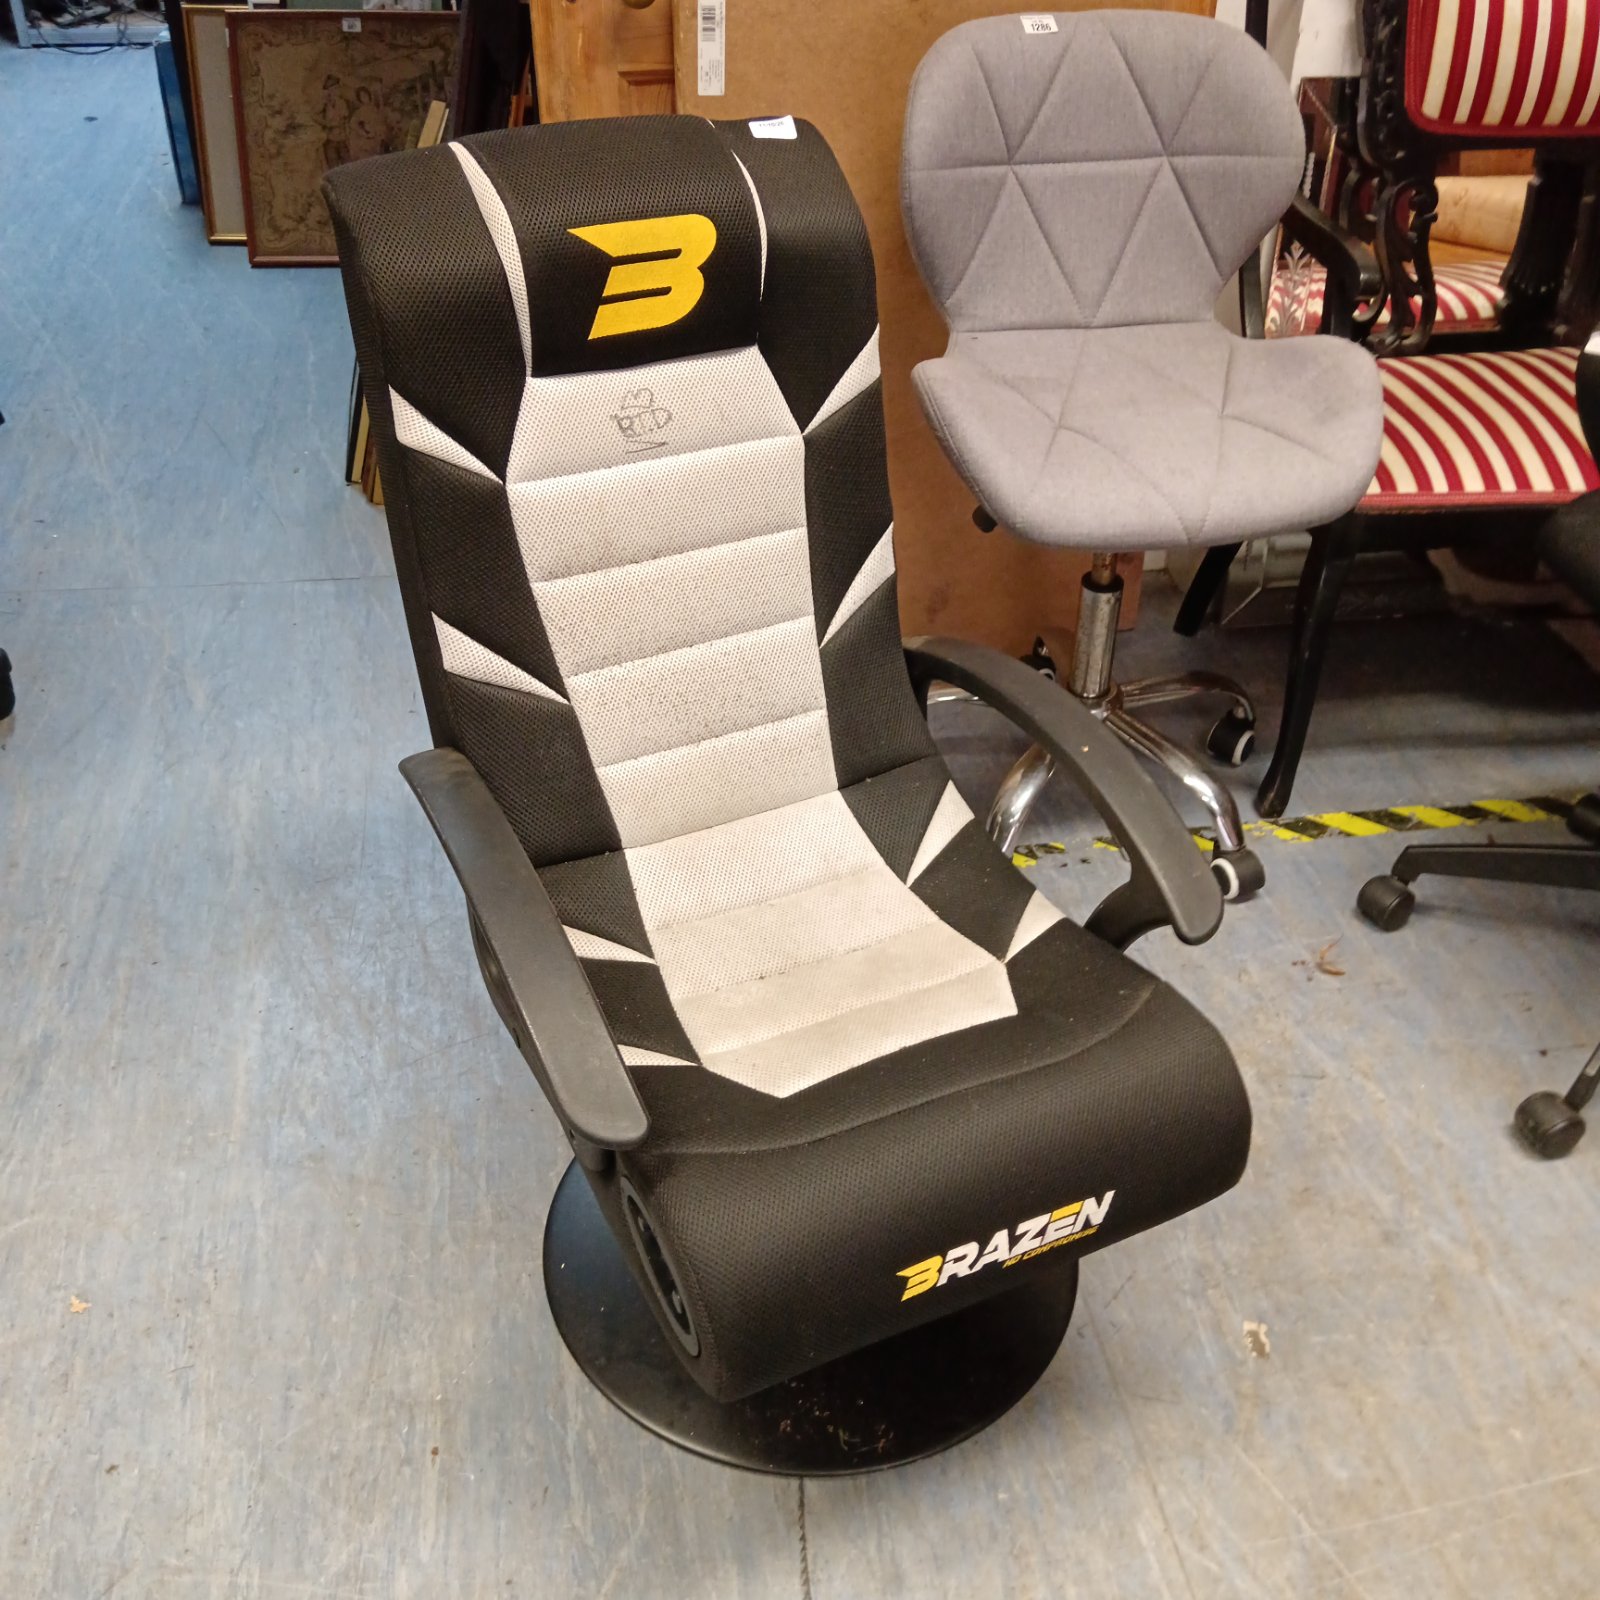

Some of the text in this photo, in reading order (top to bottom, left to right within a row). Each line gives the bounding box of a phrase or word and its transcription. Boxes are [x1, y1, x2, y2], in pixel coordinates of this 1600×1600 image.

[1031, 23, 1052, 32] 1286
[896, 1189, 1116, 1302] BRAZEN
[1002, 1254, 1022, 1269] NO
